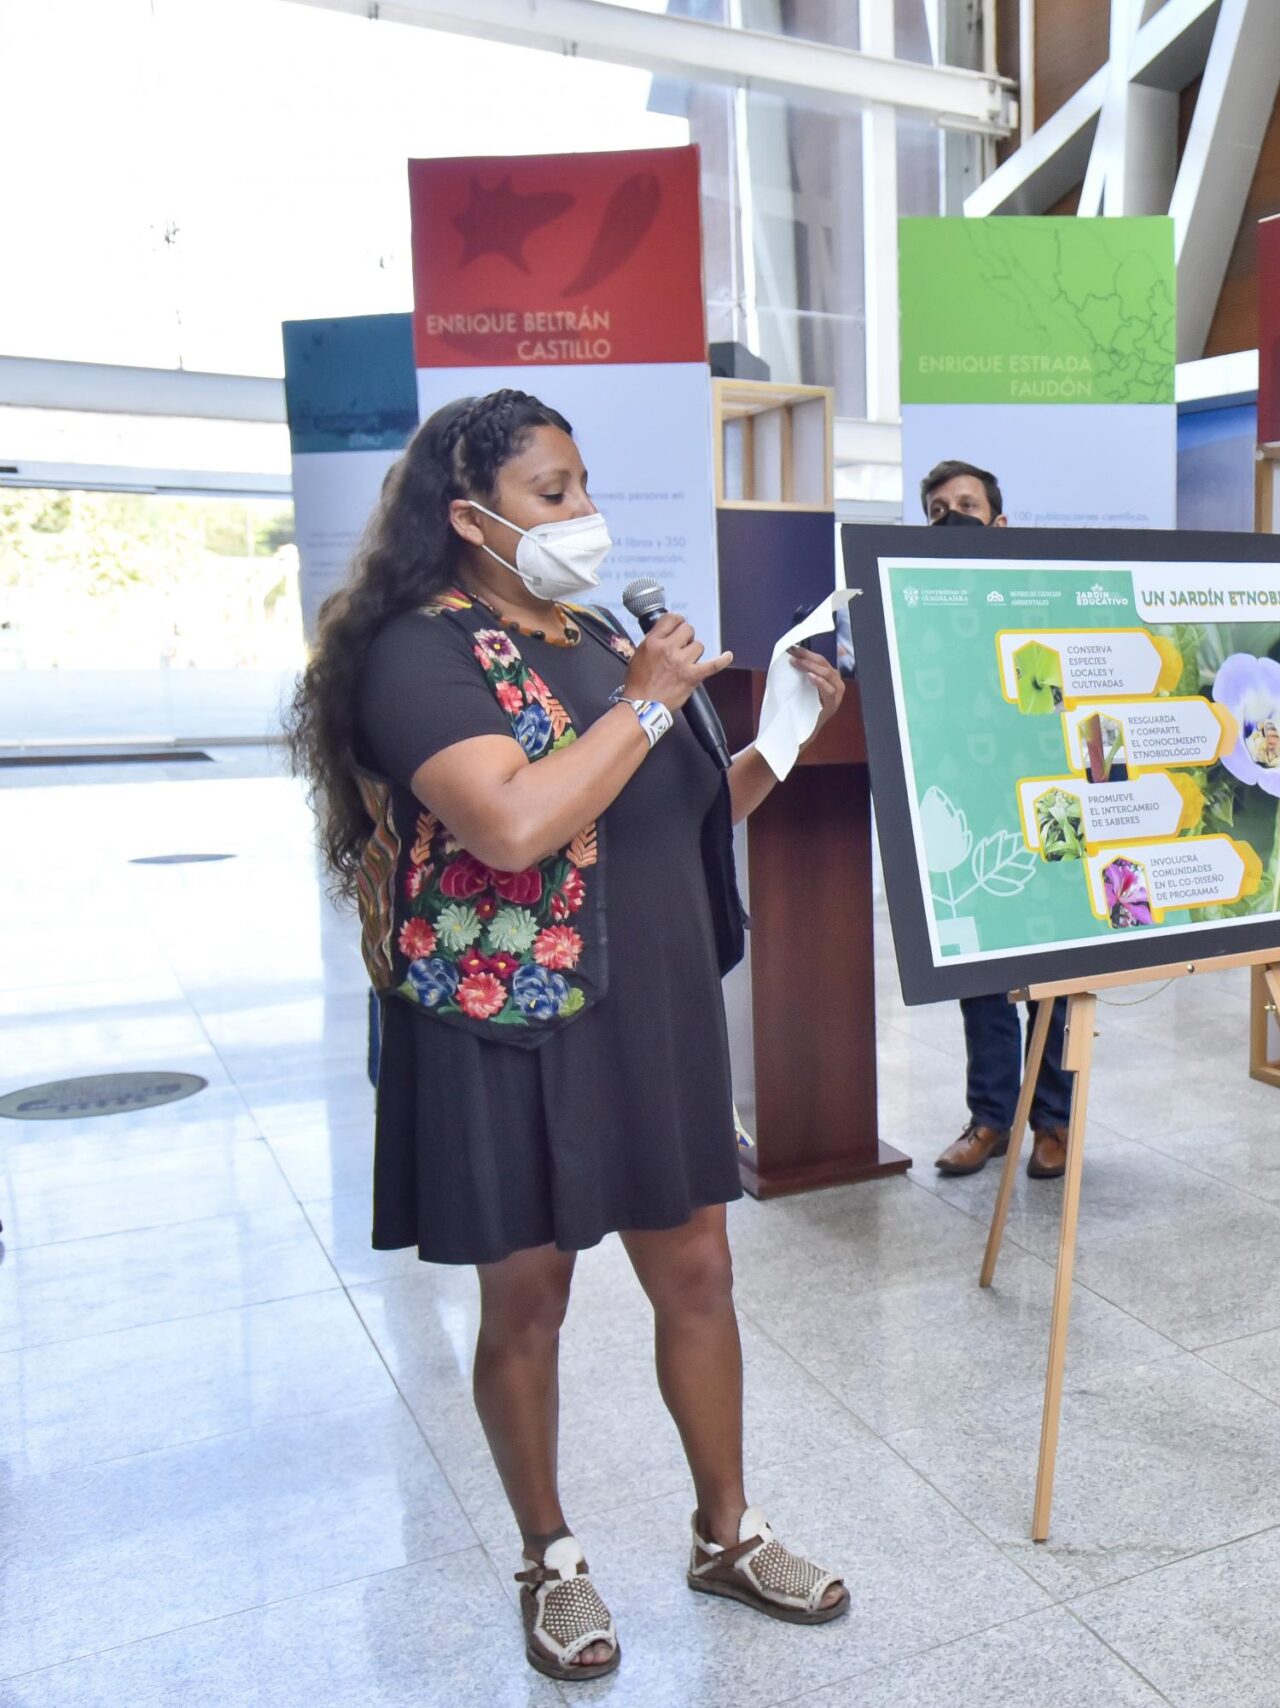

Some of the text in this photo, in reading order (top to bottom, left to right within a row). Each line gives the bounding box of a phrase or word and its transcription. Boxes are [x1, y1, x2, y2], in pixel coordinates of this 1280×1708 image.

[426, 305, 610, 335] ENRIQUE BELTRÁN
[517, 339, 611, 360] CASTILLO
[918, 355, 1092, 373] ENRIQUE ESTRADA
[1010, 377, 1092, 397] FAUDÓN
[1077, 598, 1128, 606] EDUCATIVO
[1141, 590, 1165, 606] UN
[1169, 587, 1224, 607] JARDÍN
[1067, 645, 1112, 655] CONSERVA
[1069, 656, 1107, 666] ESPECIES
[1070, 668, 1114, 678] LOCALES Y
[1072, 679, 1124, 689] CULTIVADAS
[1128, 714, 1176, 725] RESGUARDA
[1129, 726, 1181, 737] Y COMPARTE
[1131, 735, 1207, 748] EL CONOCIMIENTO
[1134, 747, 1201, 760] ETNOBIOLÓGICO
[1088, 792, 1135, 804] PROMUEVE
[1090, 802, 1160, 816] EL INTERCAMBIO
[1092, 815, 1140, 828] DE SABERES
[1150, 854, 1198, 867] INVOLUCRA
[1152, 864, 1212, 878] COMUNIDADES
[1154, 873, 1224, 889] EN EL CO-DISEÑO
[1156, 886, 1219, 901] DE PROGRAMAS
